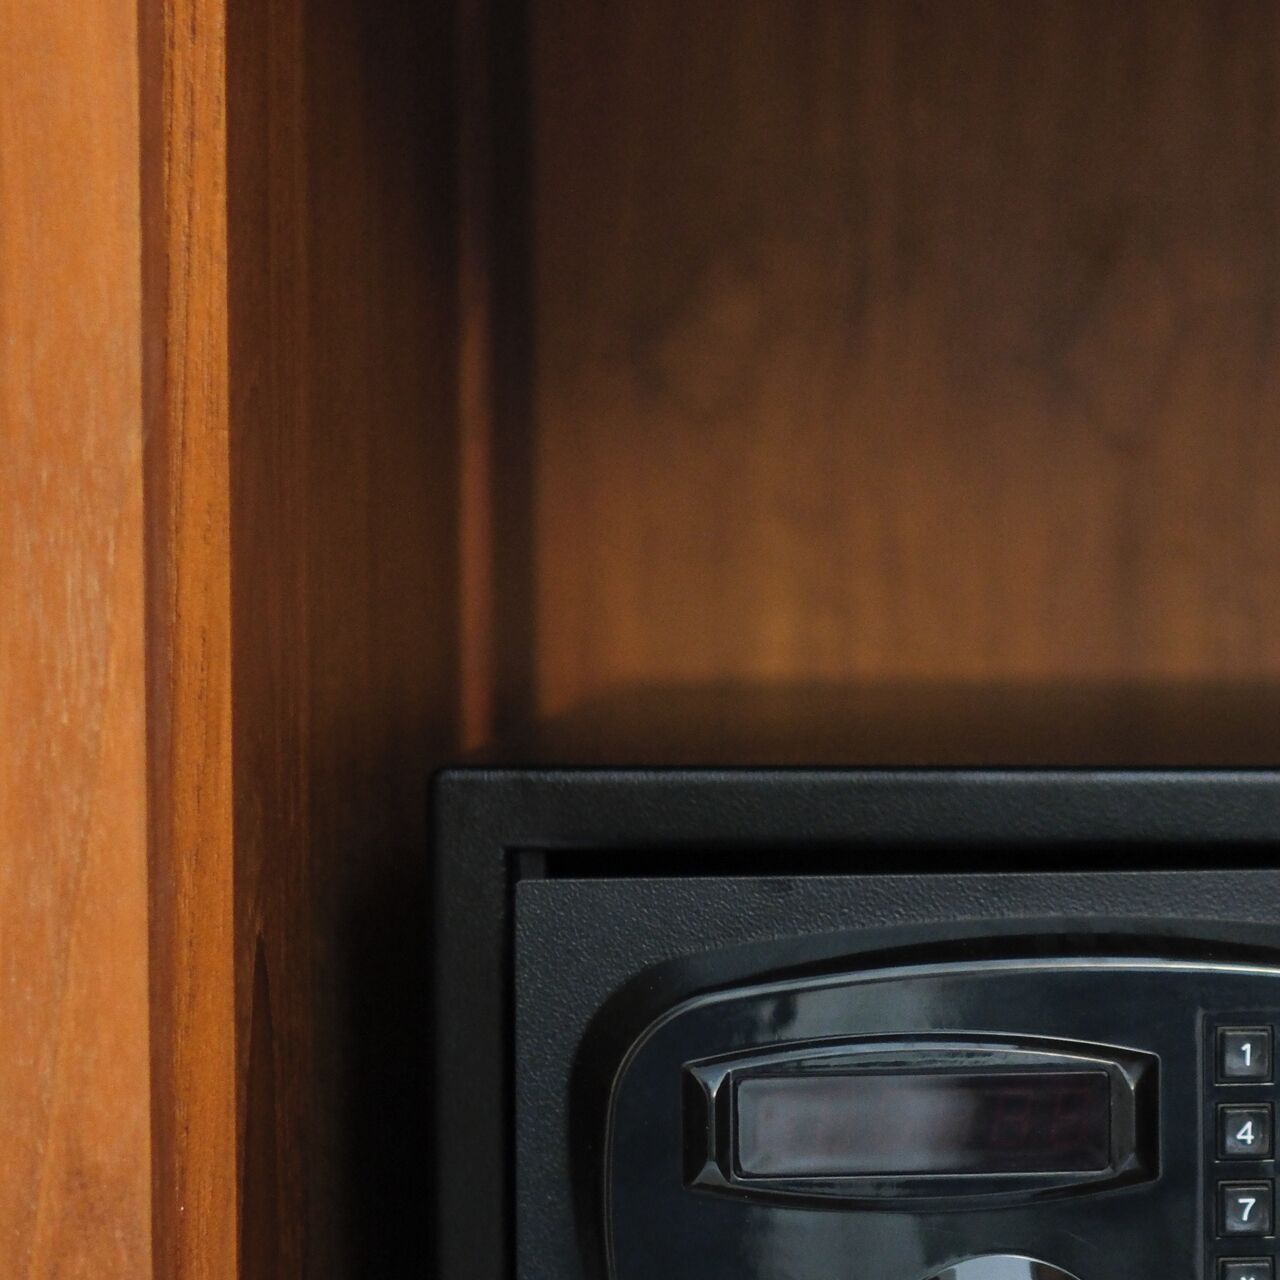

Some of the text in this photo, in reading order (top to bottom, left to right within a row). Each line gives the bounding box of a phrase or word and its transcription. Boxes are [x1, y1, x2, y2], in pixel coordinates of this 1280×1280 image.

[1240, 1042, 1252, 1067] 1
[1236, 1121, 1254, 1145] 4
[1237, 1198, 1256, 1222] 7
